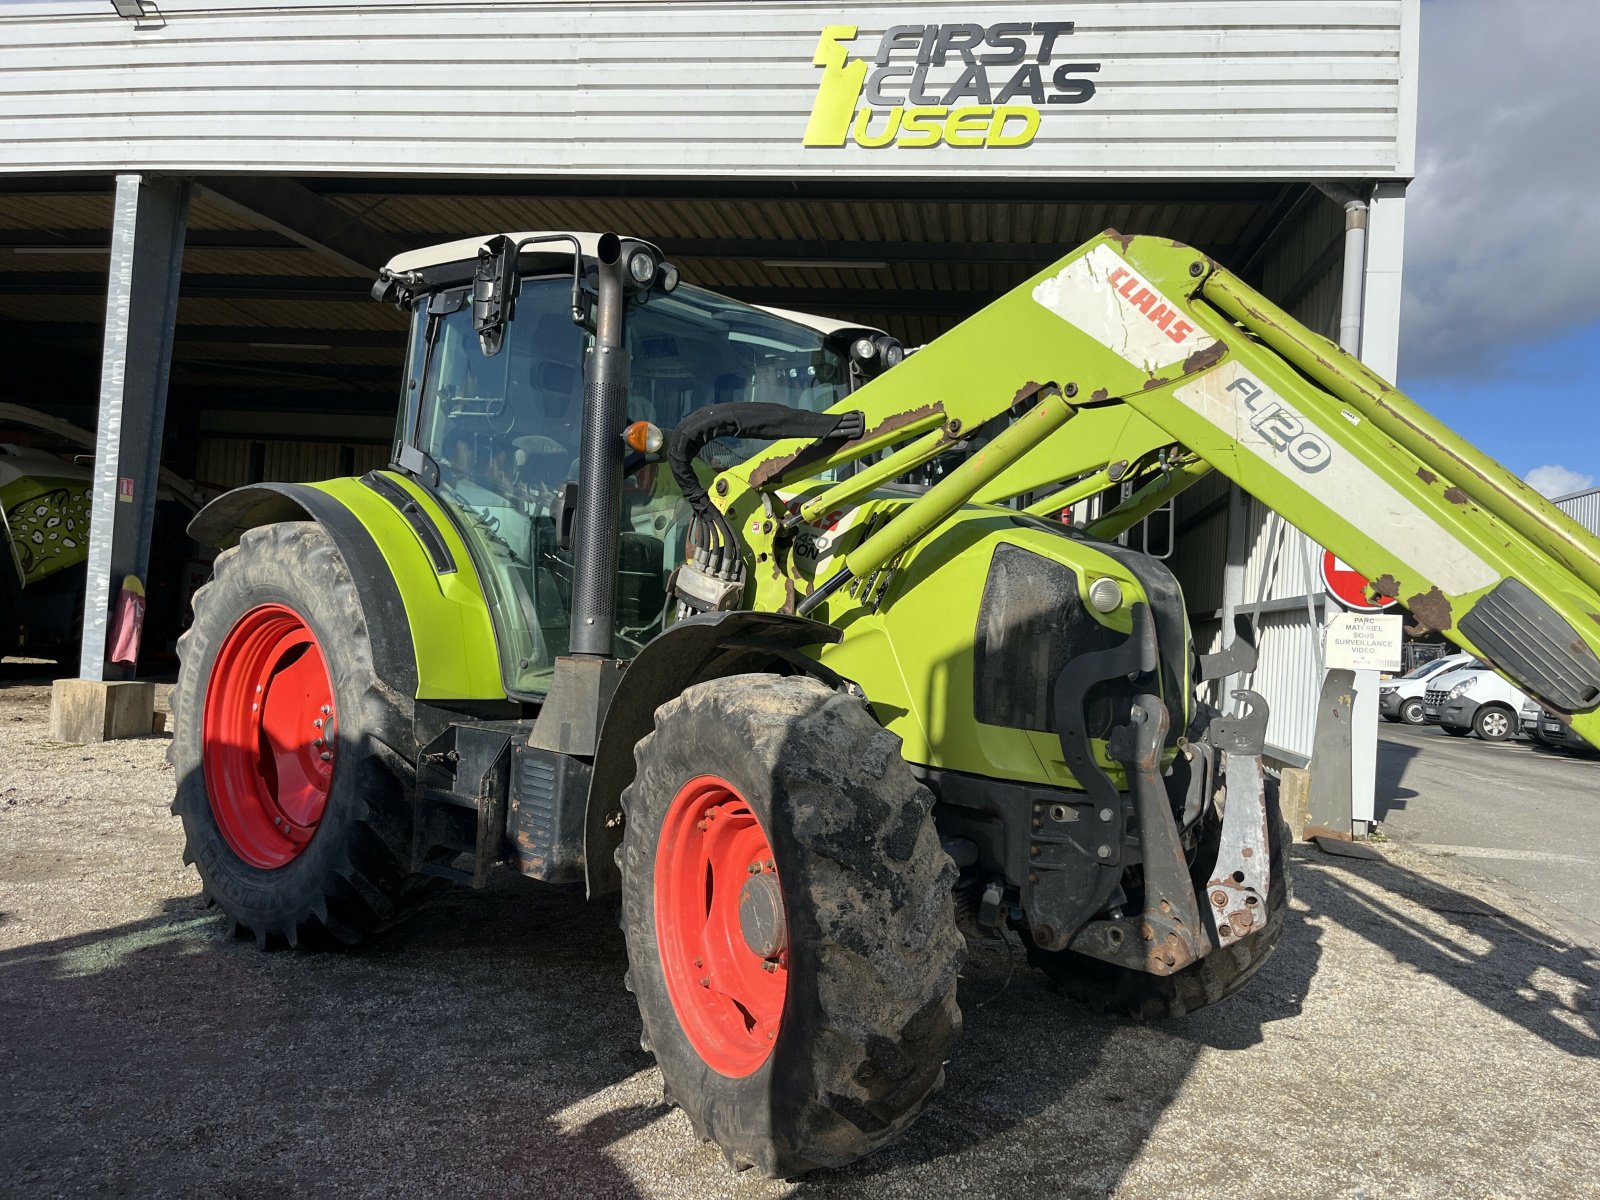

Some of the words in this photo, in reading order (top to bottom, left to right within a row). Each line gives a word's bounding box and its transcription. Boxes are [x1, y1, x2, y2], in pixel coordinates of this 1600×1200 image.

[874, 22, 1074, 65] FIRST
[866, 63, 1101, 105] CLAAS
[853, 106, 1041, 147] USED
[1107, 267, 1194, 344] CLAAS
[794, 542, 820, 560] ION
[1335, 638, 1392, 647] SURVEILLANCE
